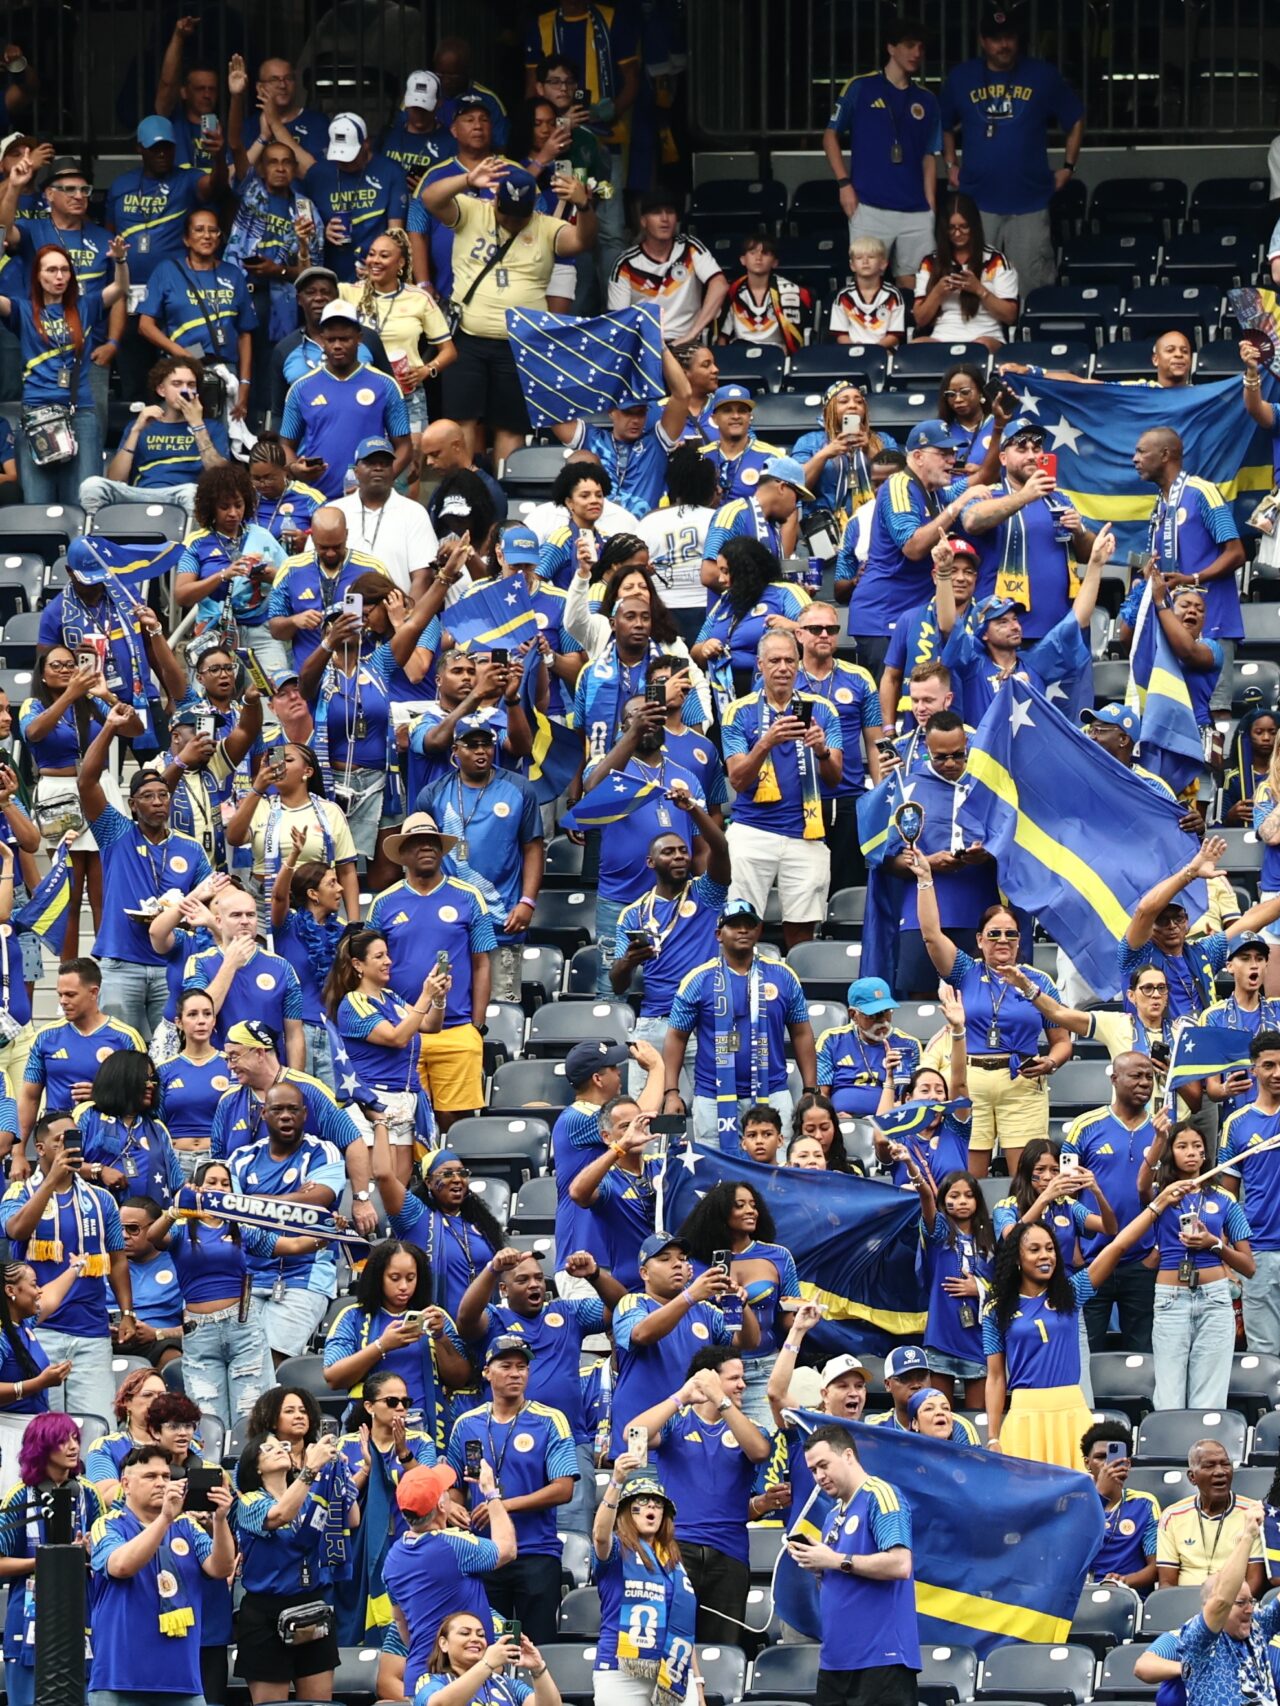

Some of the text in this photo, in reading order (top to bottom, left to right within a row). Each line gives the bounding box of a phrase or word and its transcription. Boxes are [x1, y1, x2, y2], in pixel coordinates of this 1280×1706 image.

[124, 194, 169, 206] UNITED
[331, 189, 378, 205] UNITED
[186, 288, 235, 301] UNITED
[147, 435, 196, 447] UNITED
[165, 444, 192, 452] PLAY
[666, 527, 704, 565] 12
[1003, 580, 1025, 593] YDK
[221, 1195, 319, 1228] CURAÇAO
[1033, 1318, 1050, 1344] 1
[624, 1589, 665, 1603] CURAÇAO
